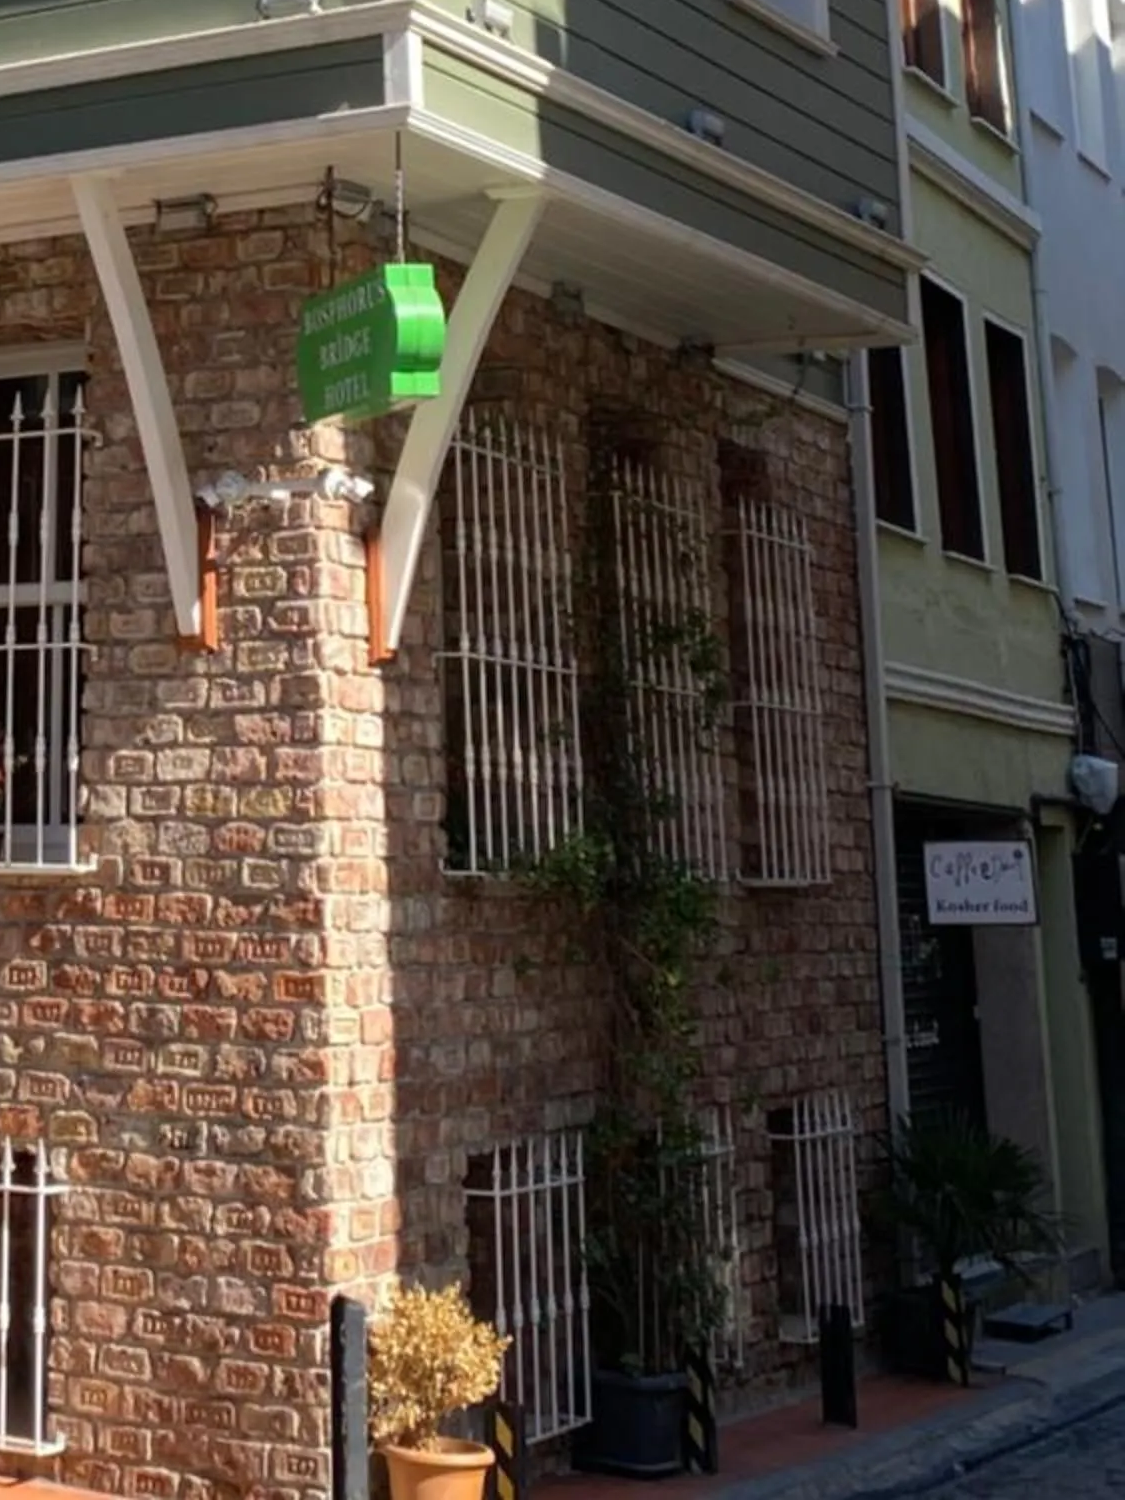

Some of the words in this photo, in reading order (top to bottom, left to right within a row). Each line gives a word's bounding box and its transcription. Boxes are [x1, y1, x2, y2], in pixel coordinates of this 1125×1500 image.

[325, 372, 371, 410] HOTEL
[936, 898, 989, 912] Kosher
[993, 898, 1028, 912] food
